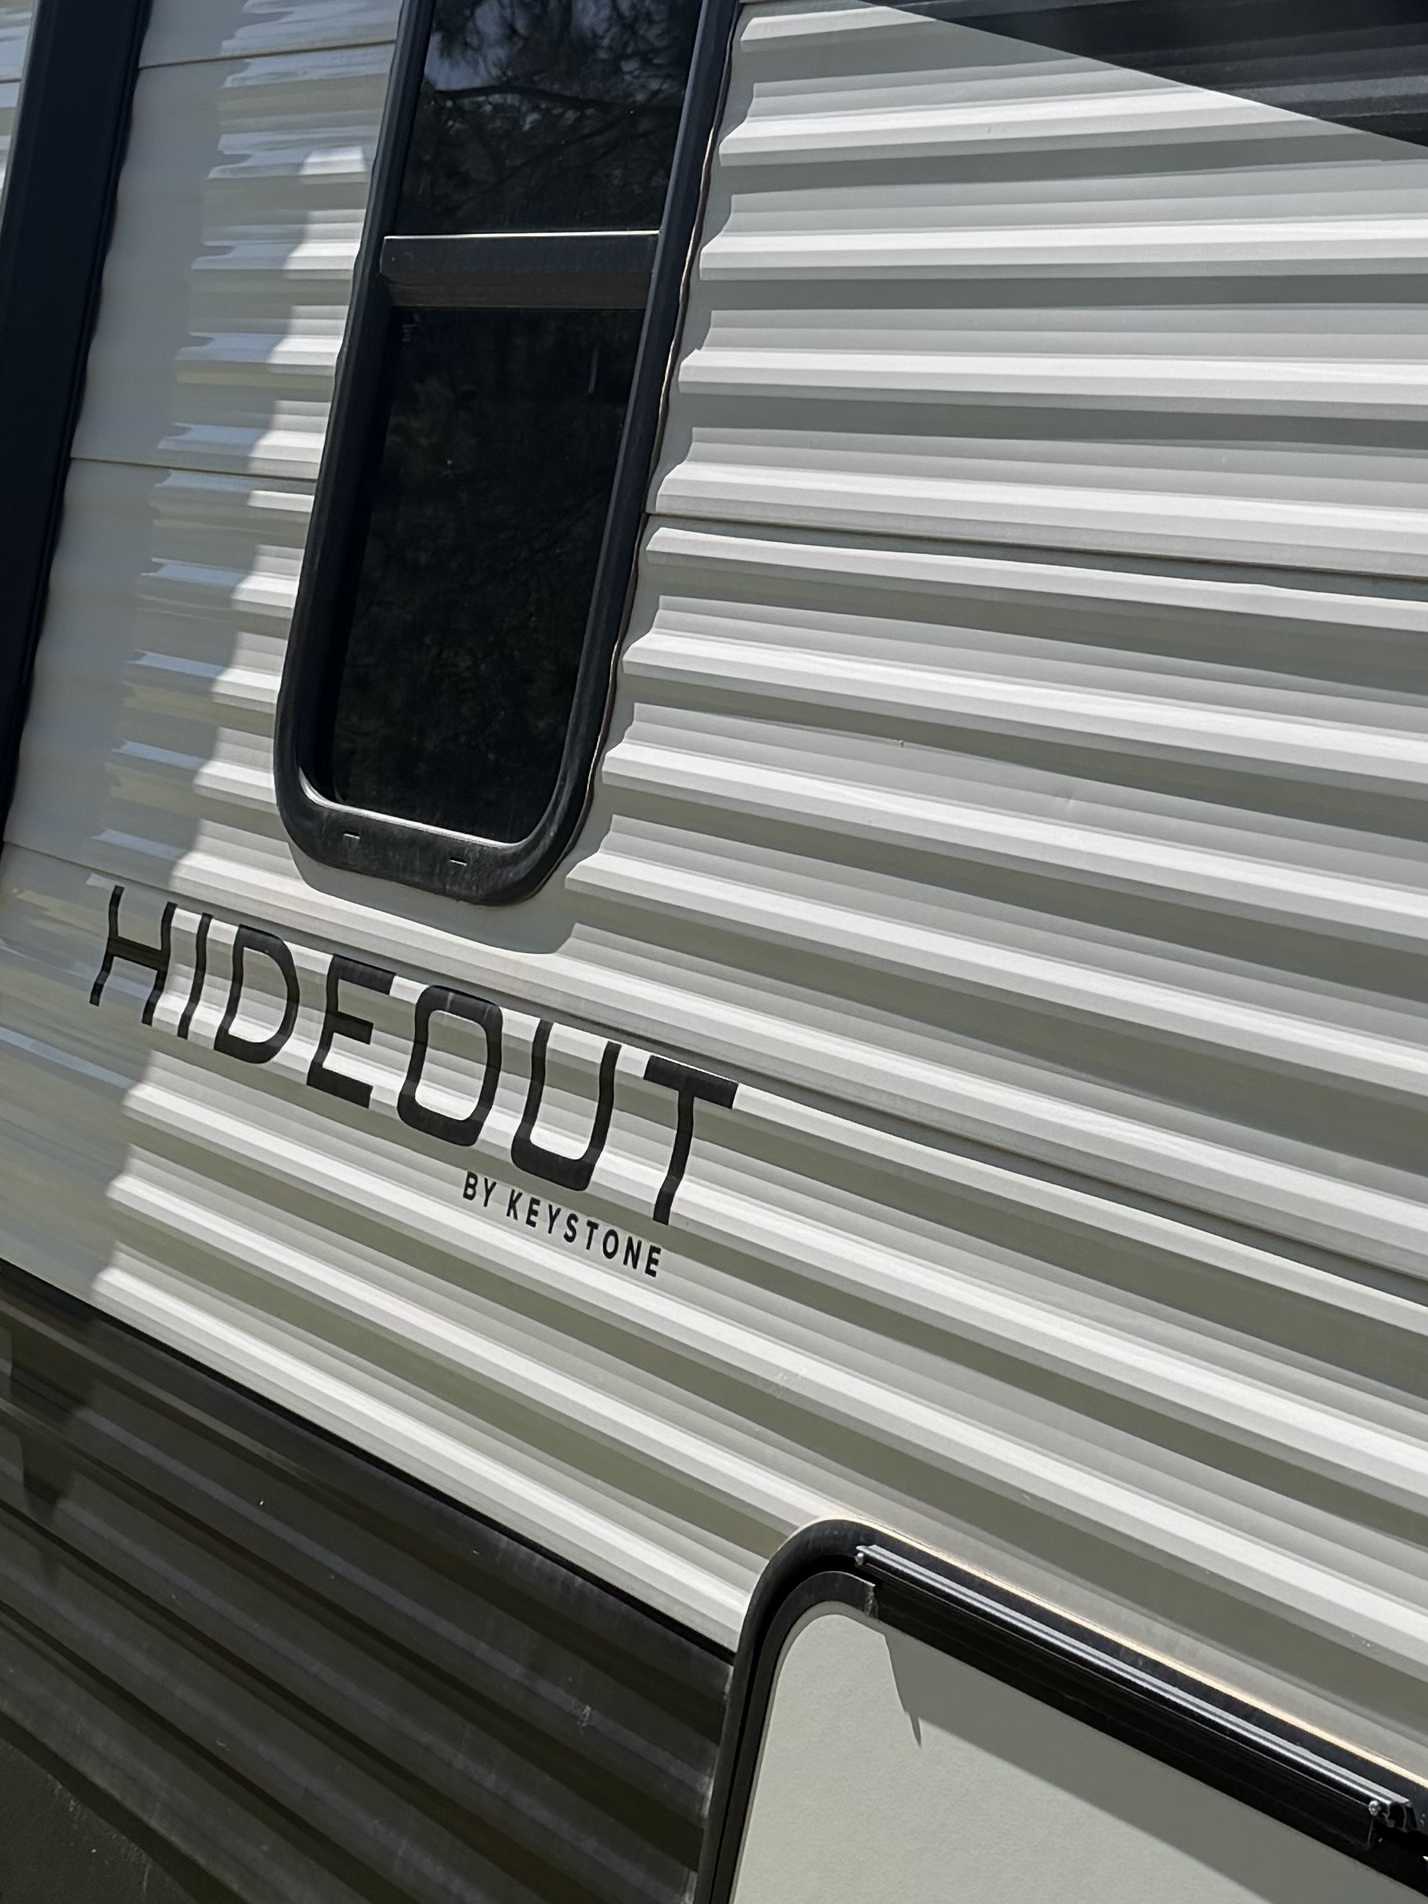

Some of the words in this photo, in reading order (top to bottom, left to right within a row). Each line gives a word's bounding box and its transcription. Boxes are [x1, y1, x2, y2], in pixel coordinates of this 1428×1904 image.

[88, 884, 739, 1226] HIDEOUT
[462, 1170, 497, 1208] BY
[506, 1188, 662, 1278] KEYSTONE
